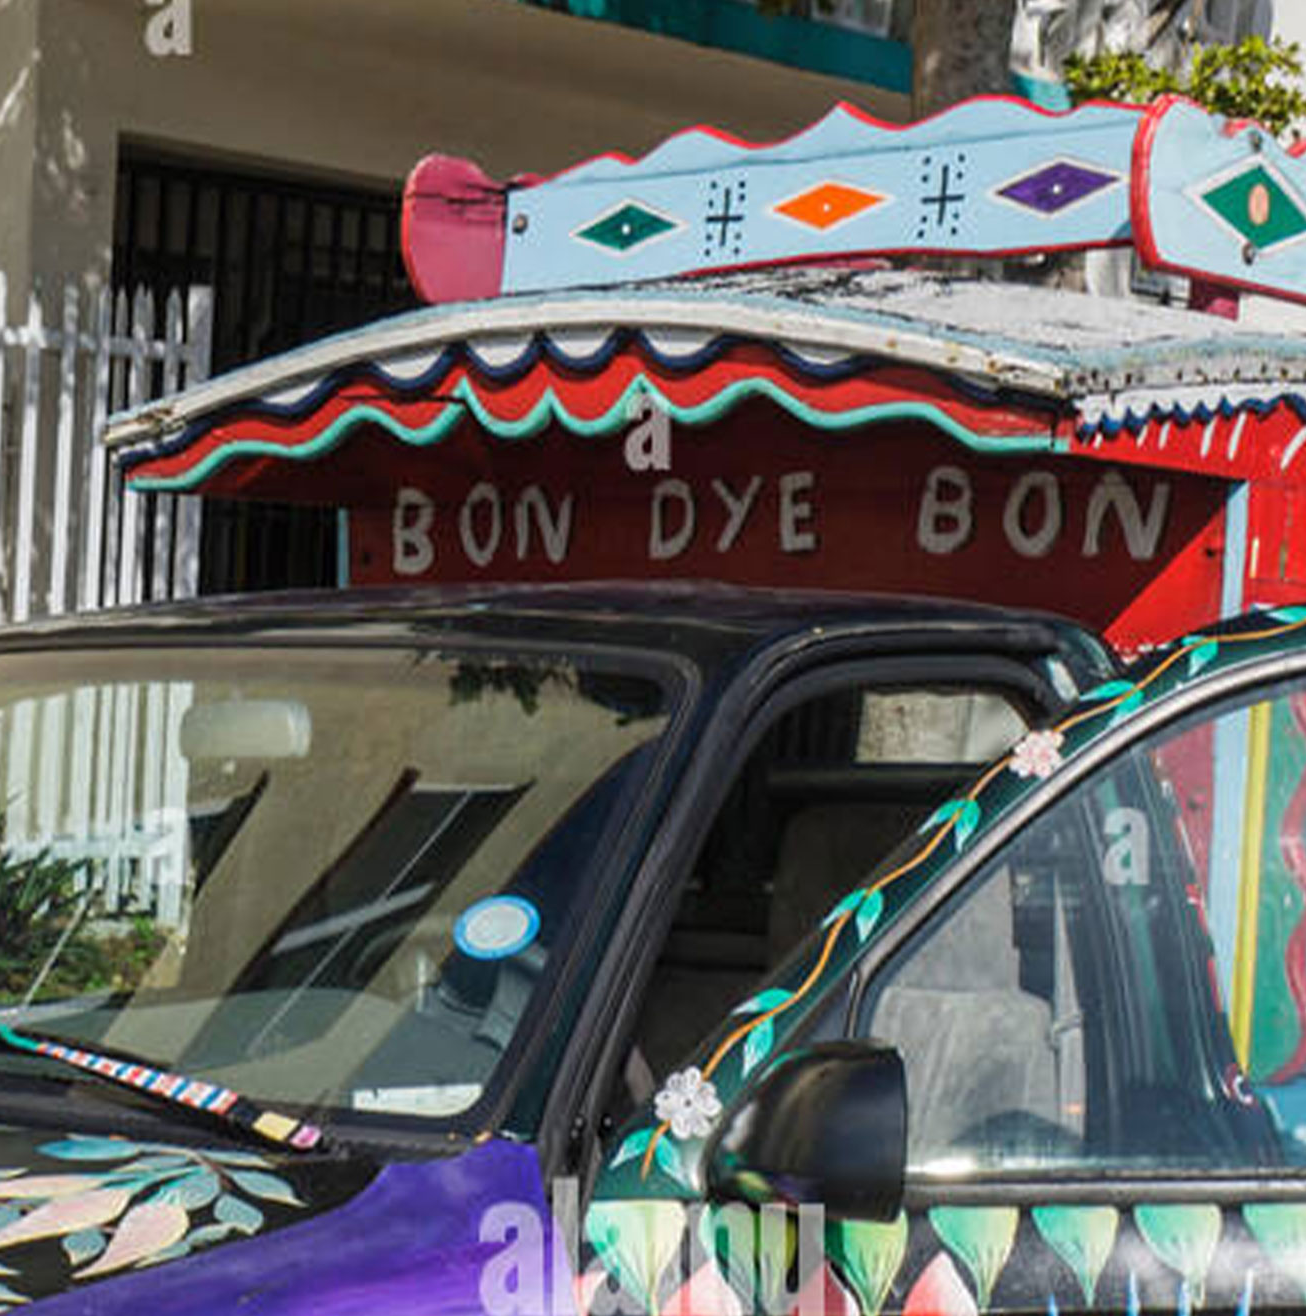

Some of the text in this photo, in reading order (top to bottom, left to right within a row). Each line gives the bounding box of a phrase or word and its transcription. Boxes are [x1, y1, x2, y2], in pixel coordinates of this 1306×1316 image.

[391, 466, 1171, 575] BON DYE BON
